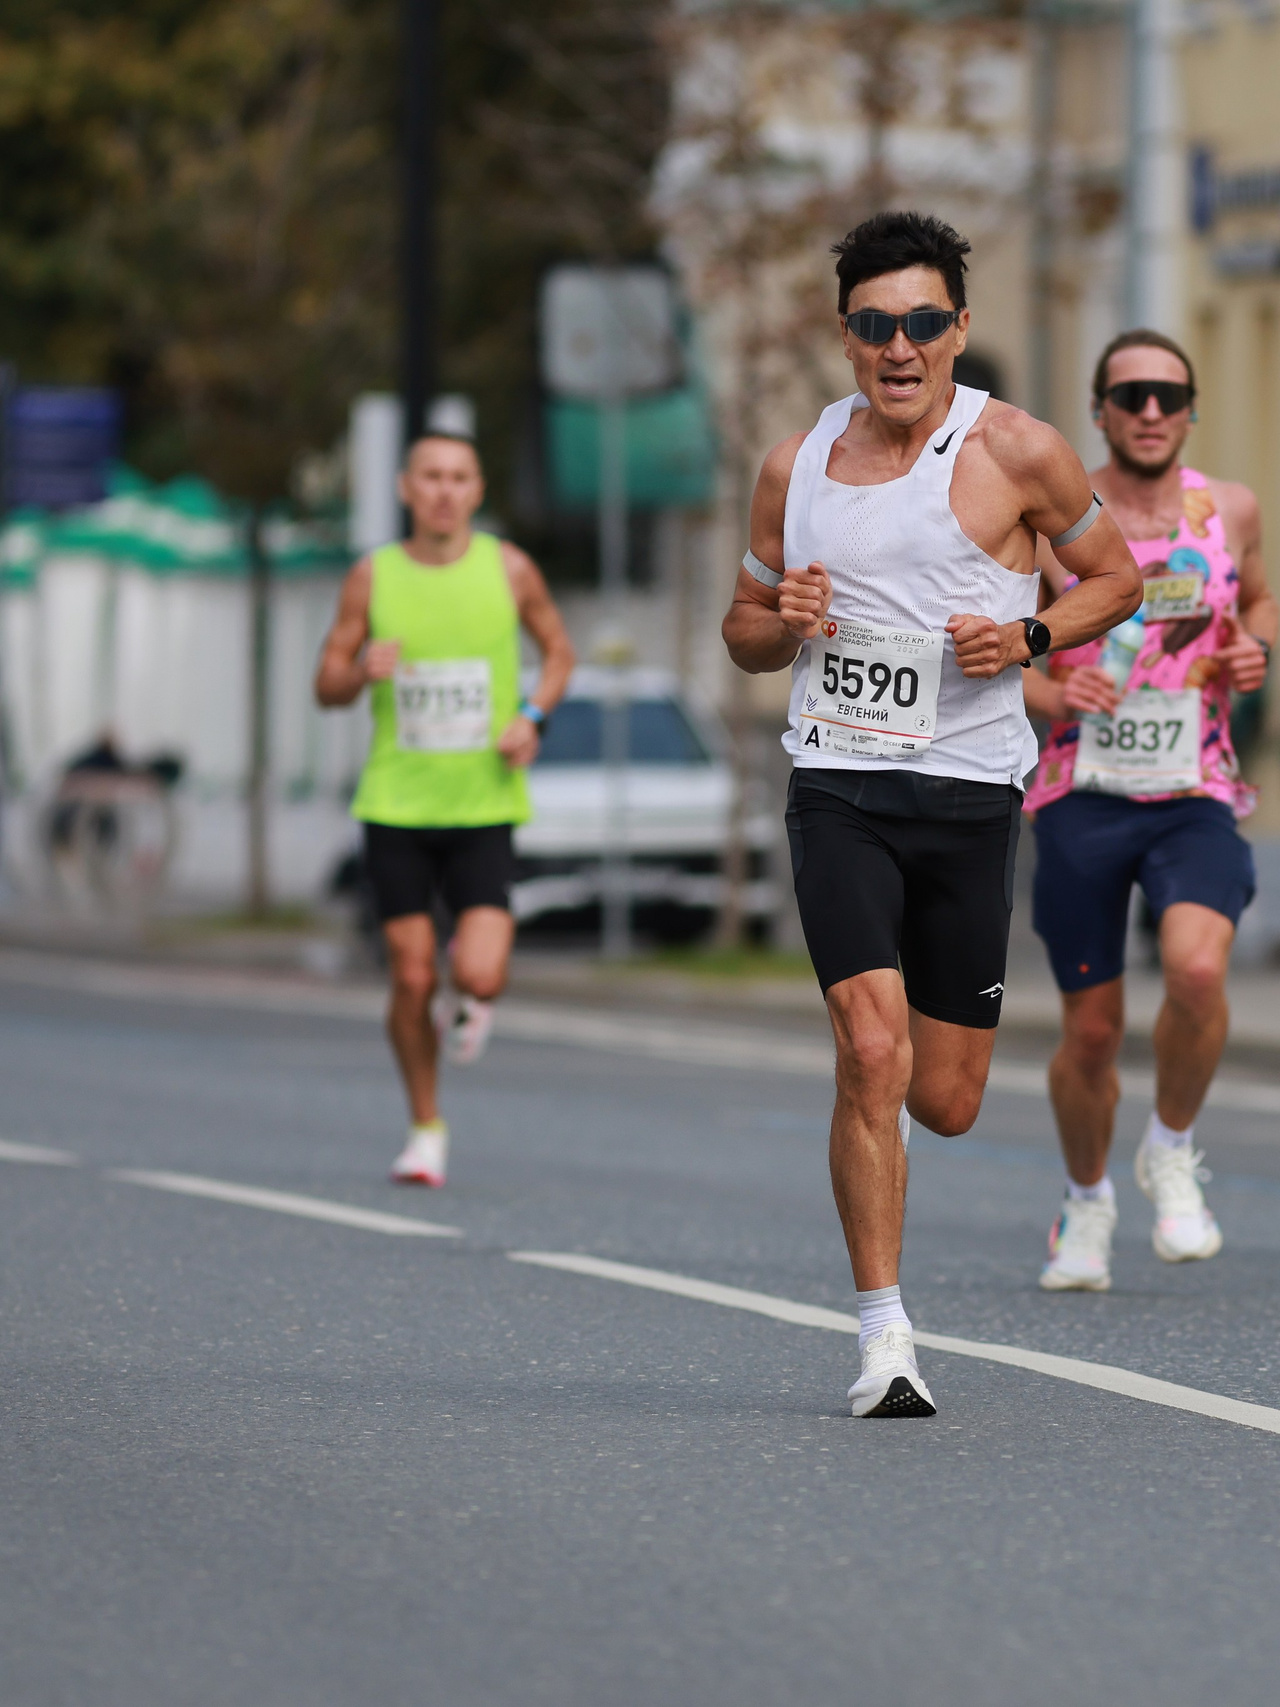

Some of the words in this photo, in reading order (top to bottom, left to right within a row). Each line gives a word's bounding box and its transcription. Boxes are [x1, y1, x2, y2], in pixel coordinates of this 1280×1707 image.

[839, 623, 873, 634] СБЕРПРАЙМ
[838, 636, 872, 648] МАРАФОН
[839, 629, 886, 643] МОСКОВСКИЙ
[822, 652, 919, 708] 5590
[837, 703, 889, 723] ЕВГЕНИЙ
[919, 719, 925, 727] 2
[1096, 718, 1185, 753] 5837
